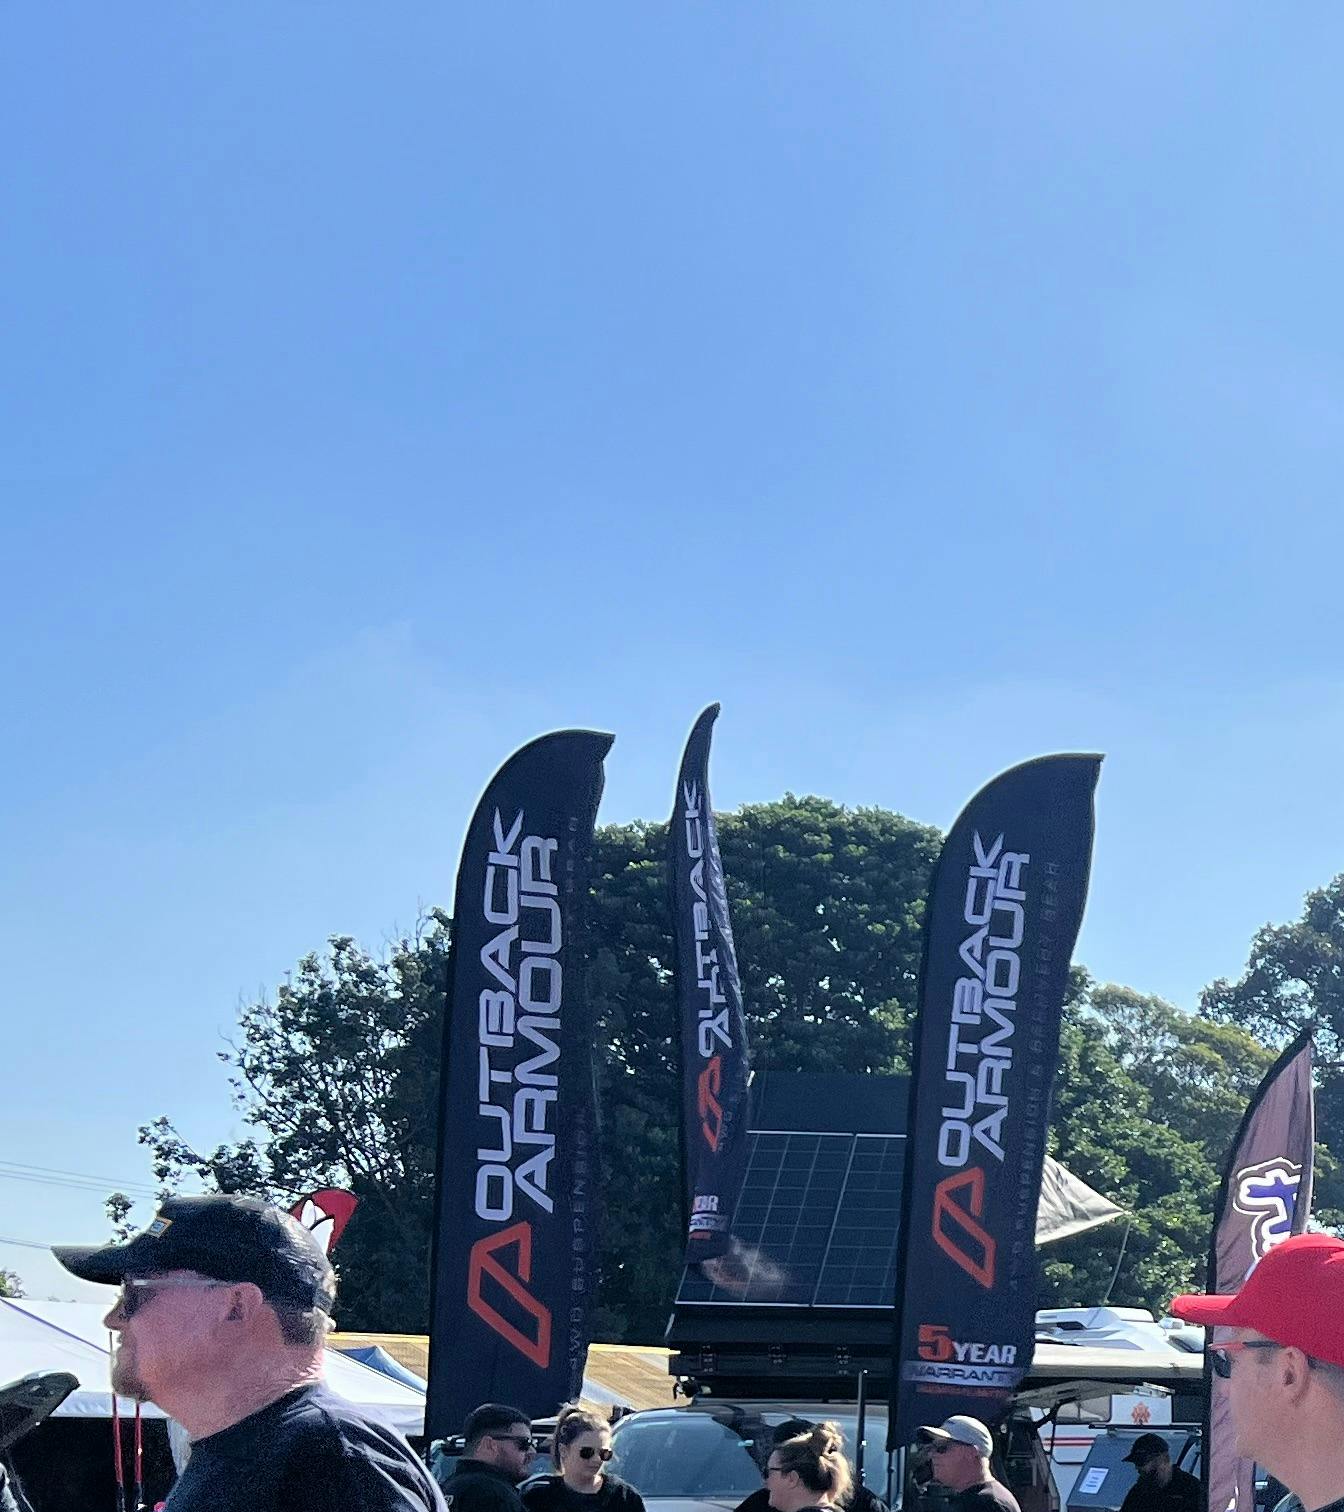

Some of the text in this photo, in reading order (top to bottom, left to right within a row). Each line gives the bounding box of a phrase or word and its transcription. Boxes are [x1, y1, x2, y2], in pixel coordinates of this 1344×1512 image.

[474, 806, 524, 1222] OUTBACK
[512, 835, 562, 1214] ARMOUR
[937, 830, 1004, 1167] OUTBACK
[972, 851, 1030, 1162] ARMOUR
[907, 1364, 1022, 1387] ARRANT
[917, 1323, 1018, 1365] 5 YEAR
